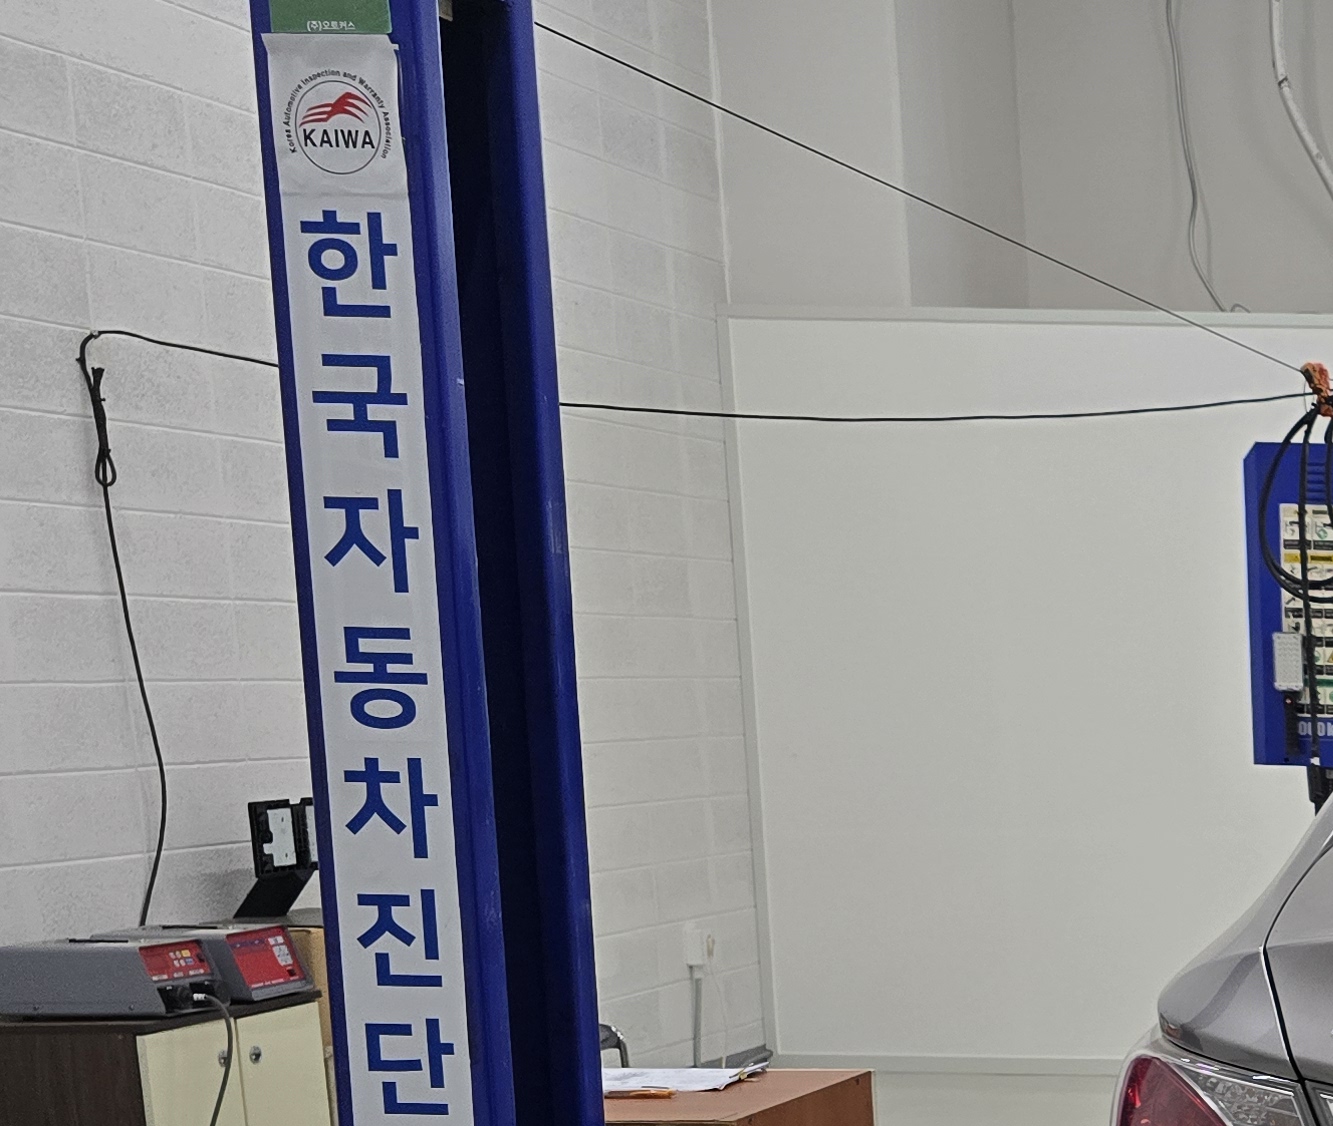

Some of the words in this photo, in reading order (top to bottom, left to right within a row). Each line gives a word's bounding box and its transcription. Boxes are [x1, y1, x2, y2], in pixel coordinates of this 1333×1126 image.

[301, 69, 341, 86] Inspection
[343, 71, 357, 82] and
[358, 77, 385, 109] Warranty
[302, 128, 375, 149] KAIWA
